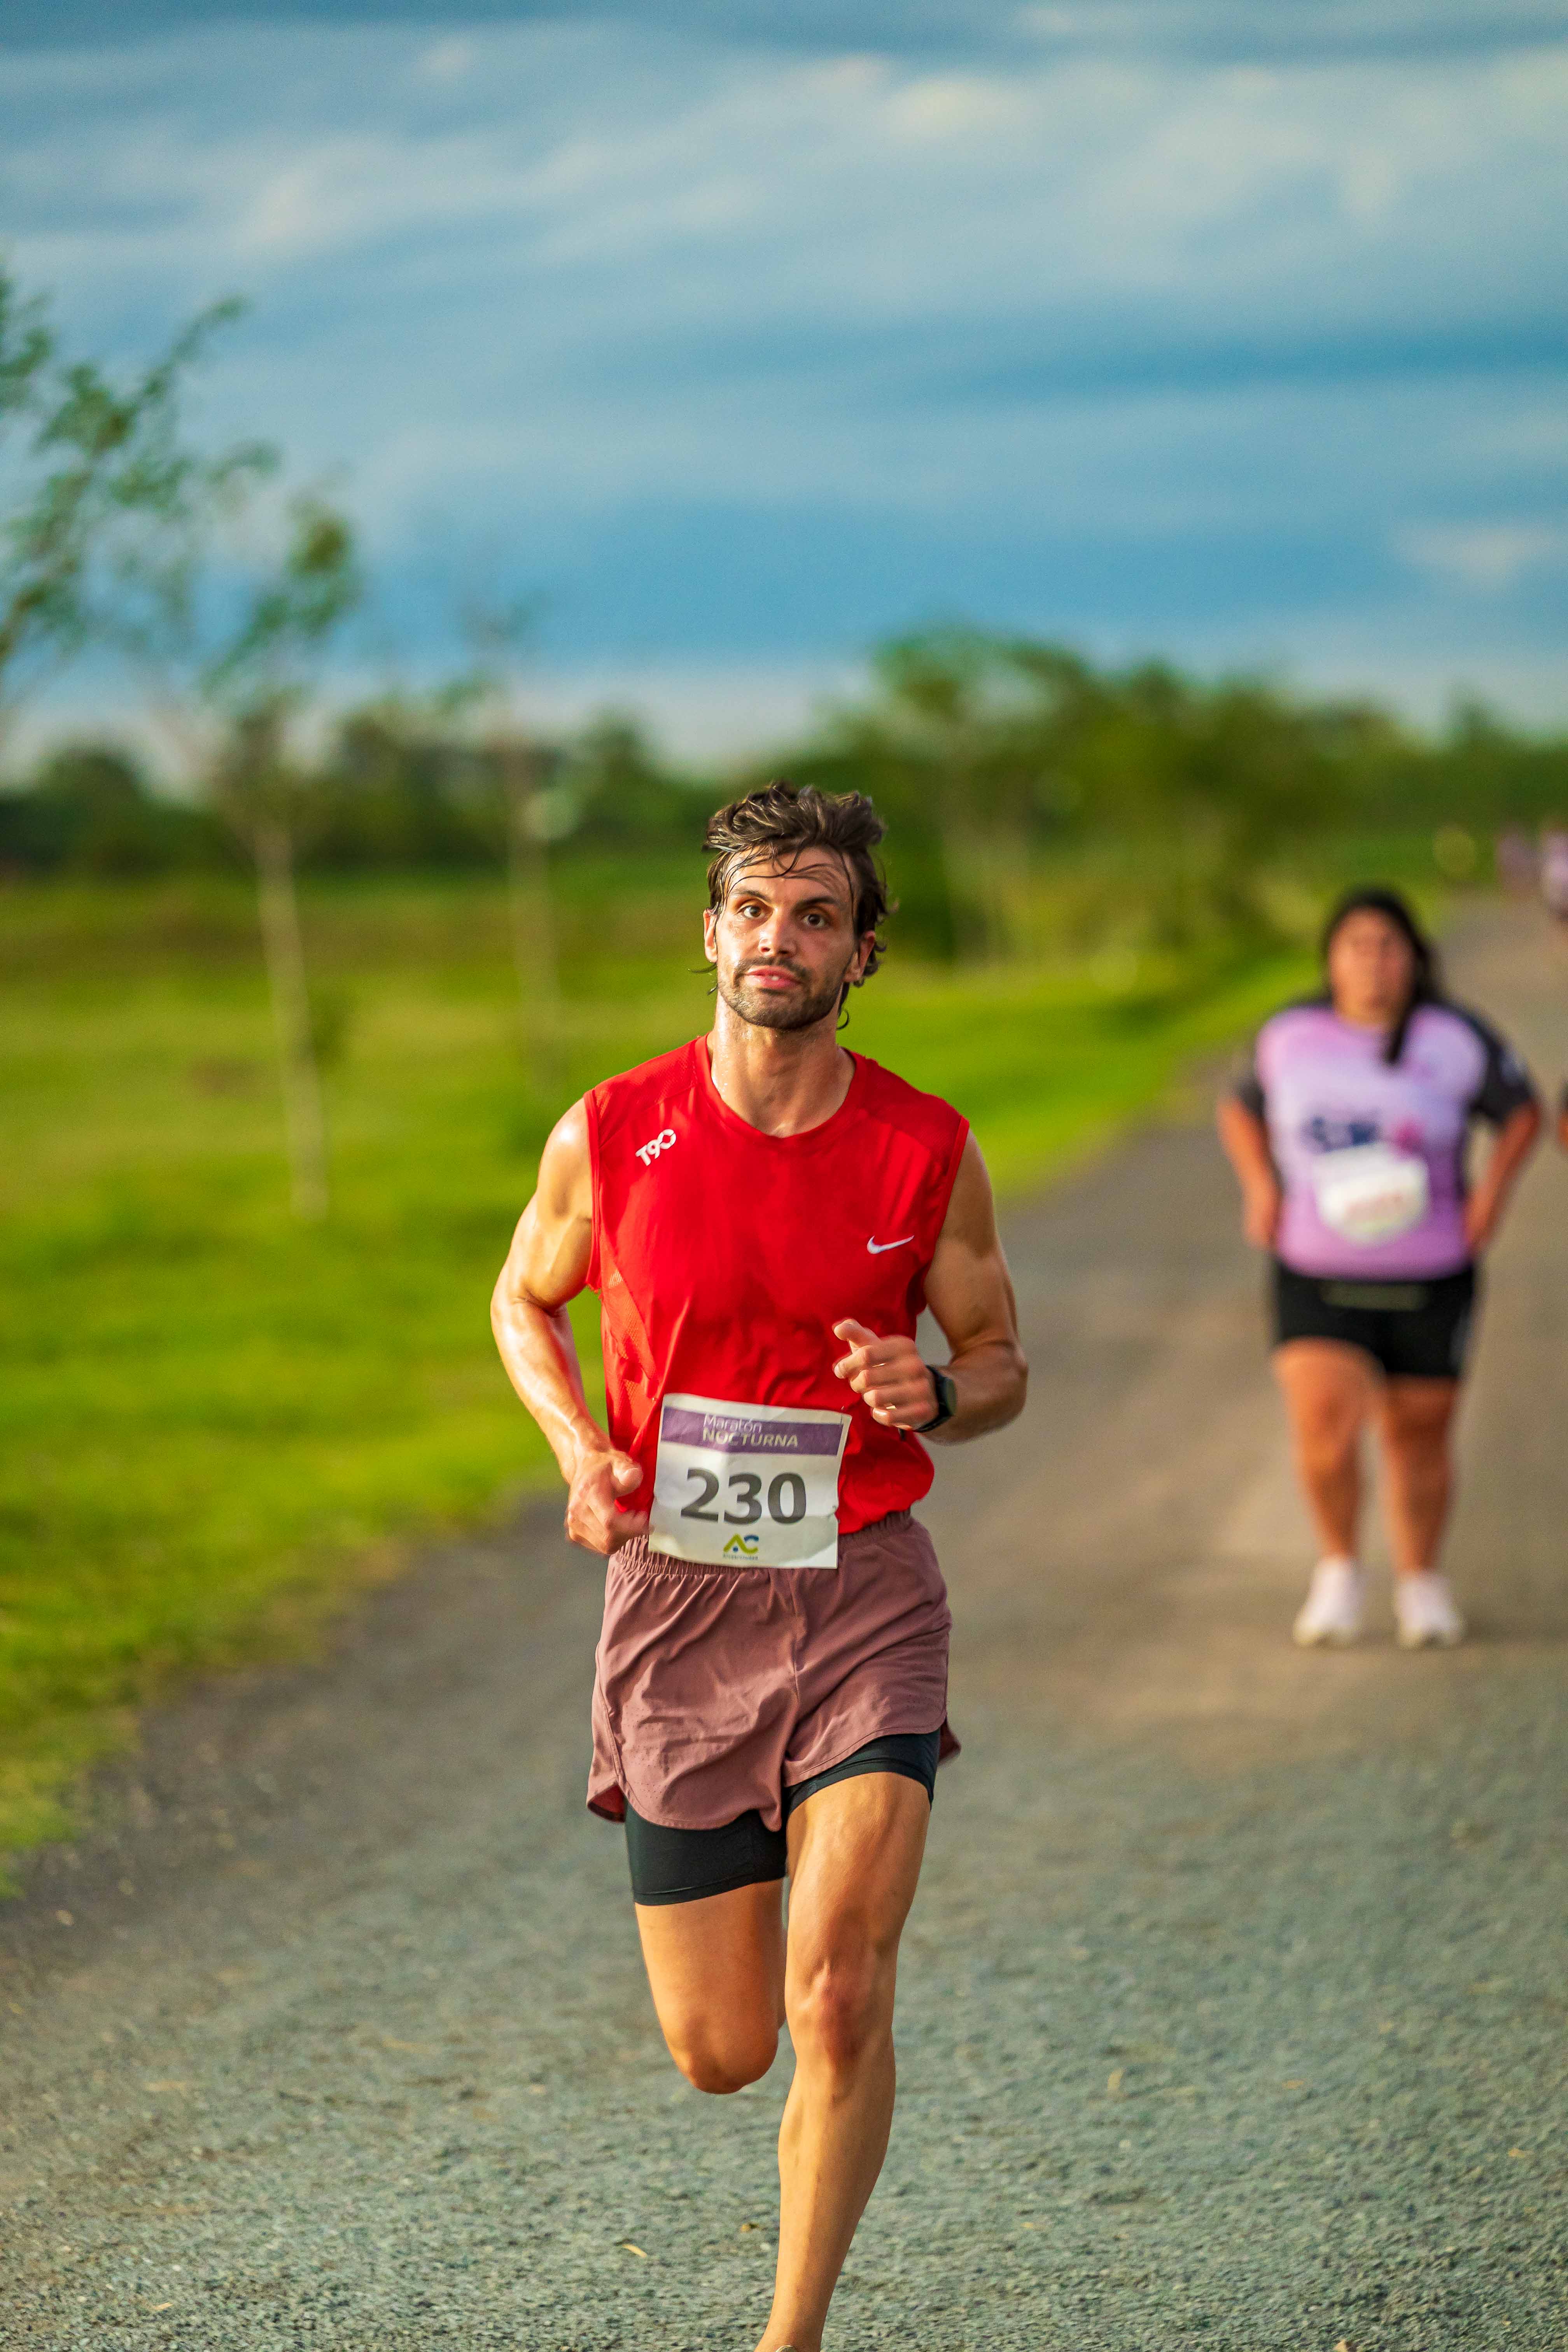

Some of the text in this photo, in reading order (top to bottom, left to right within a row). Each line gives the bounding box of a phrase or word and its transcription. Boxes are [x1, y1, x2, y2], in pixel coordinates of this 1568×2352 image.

[703, 1413, 762, 1434] Maratón
[703, 1427, 799, 1447] NOCTURNA
[681, 1468, 807, 1525] 230
